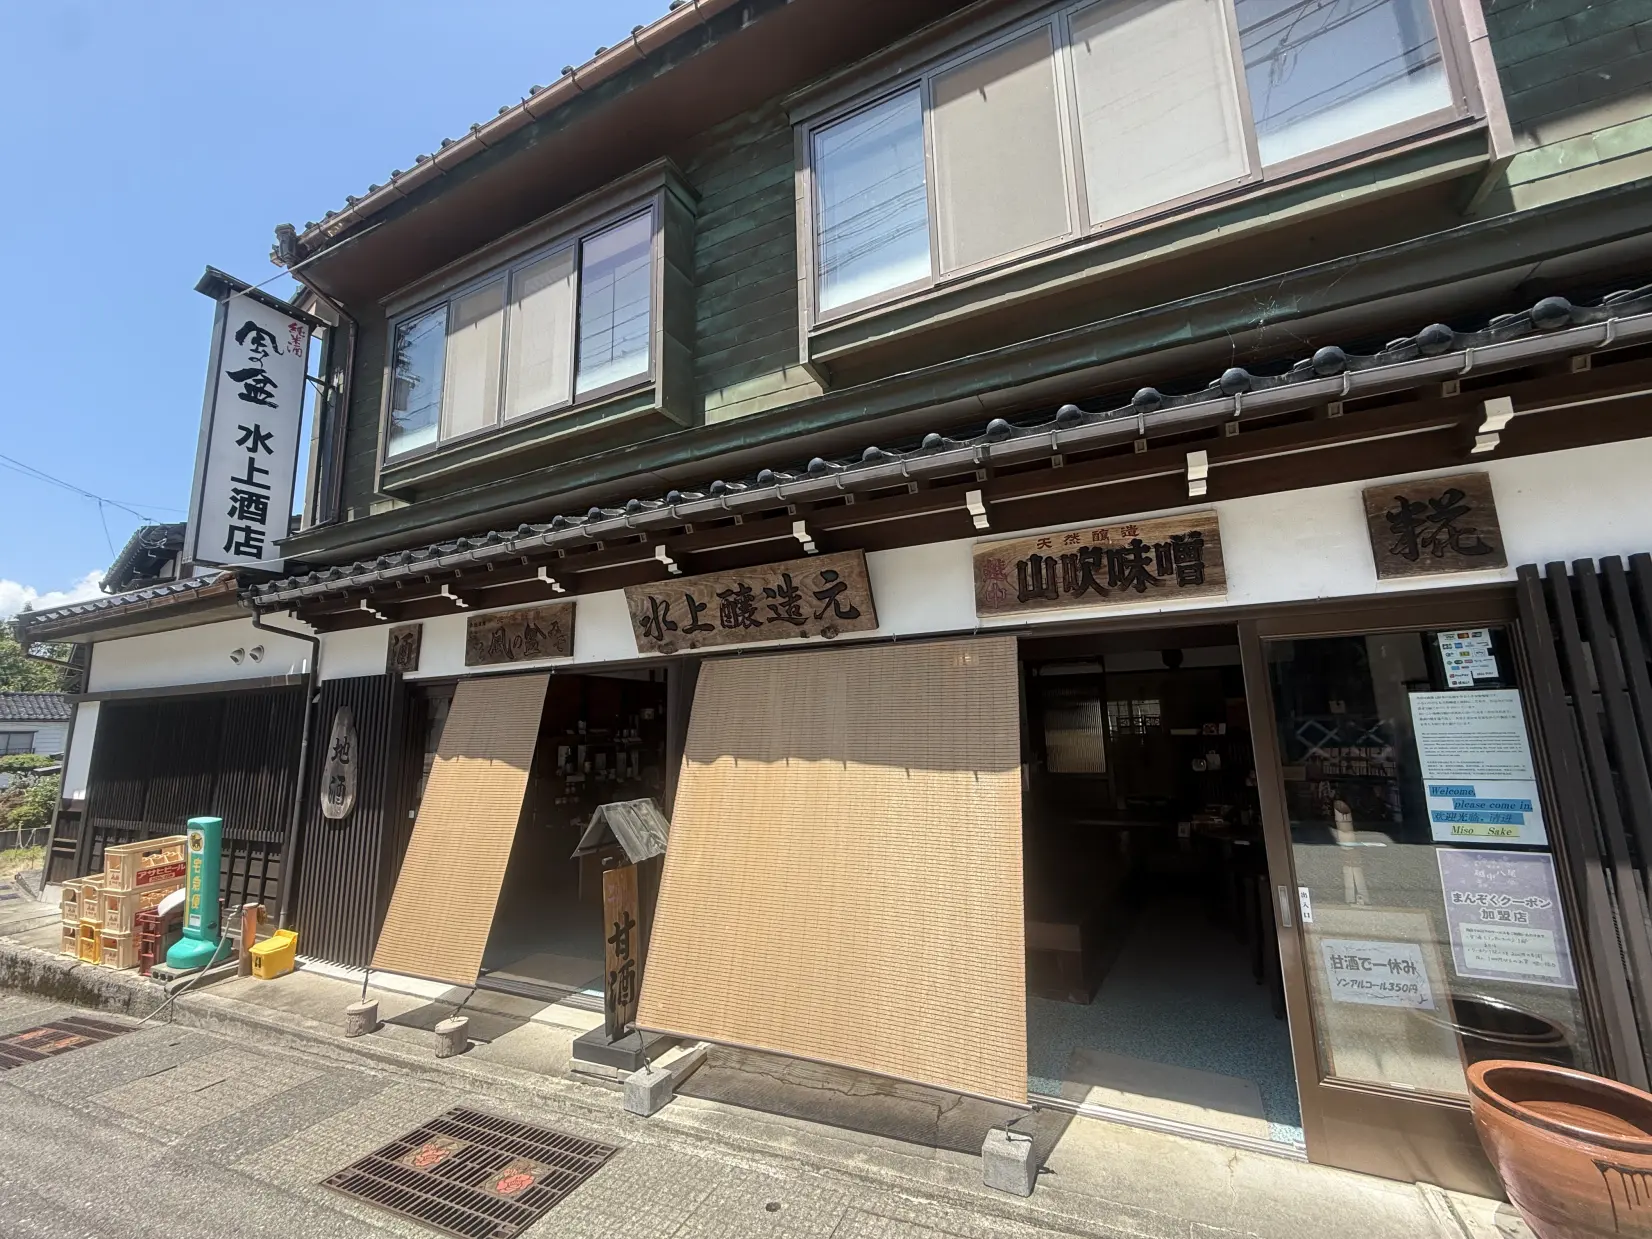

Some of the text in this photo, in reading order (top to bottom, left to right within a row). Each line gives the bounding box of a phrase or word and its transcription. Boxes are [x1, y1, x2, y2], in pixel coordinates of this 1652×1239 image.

[222, 423, 275, 560] 水上酒店
[1016, 530, 1205, 604] 山吹味噌
[1431, 786, 1476, 796] Welcome,
[1454, 800, 1486, 810] please
[1489, 802, 1516, 810] come
[1452, 825, 1512, 836] Miso Sake
[137, 863, 186, 879] アサヒビール
[1301, 891, 1311, 919] 出入口
[1452, 892, 1551, 909] まんぞくクーポン
[1481, 909, 1528, 923] 加盟店
[607, 910, 636, 1013] 甘酒
[1330, 954, 1418, 975] 甘酒で一休み
